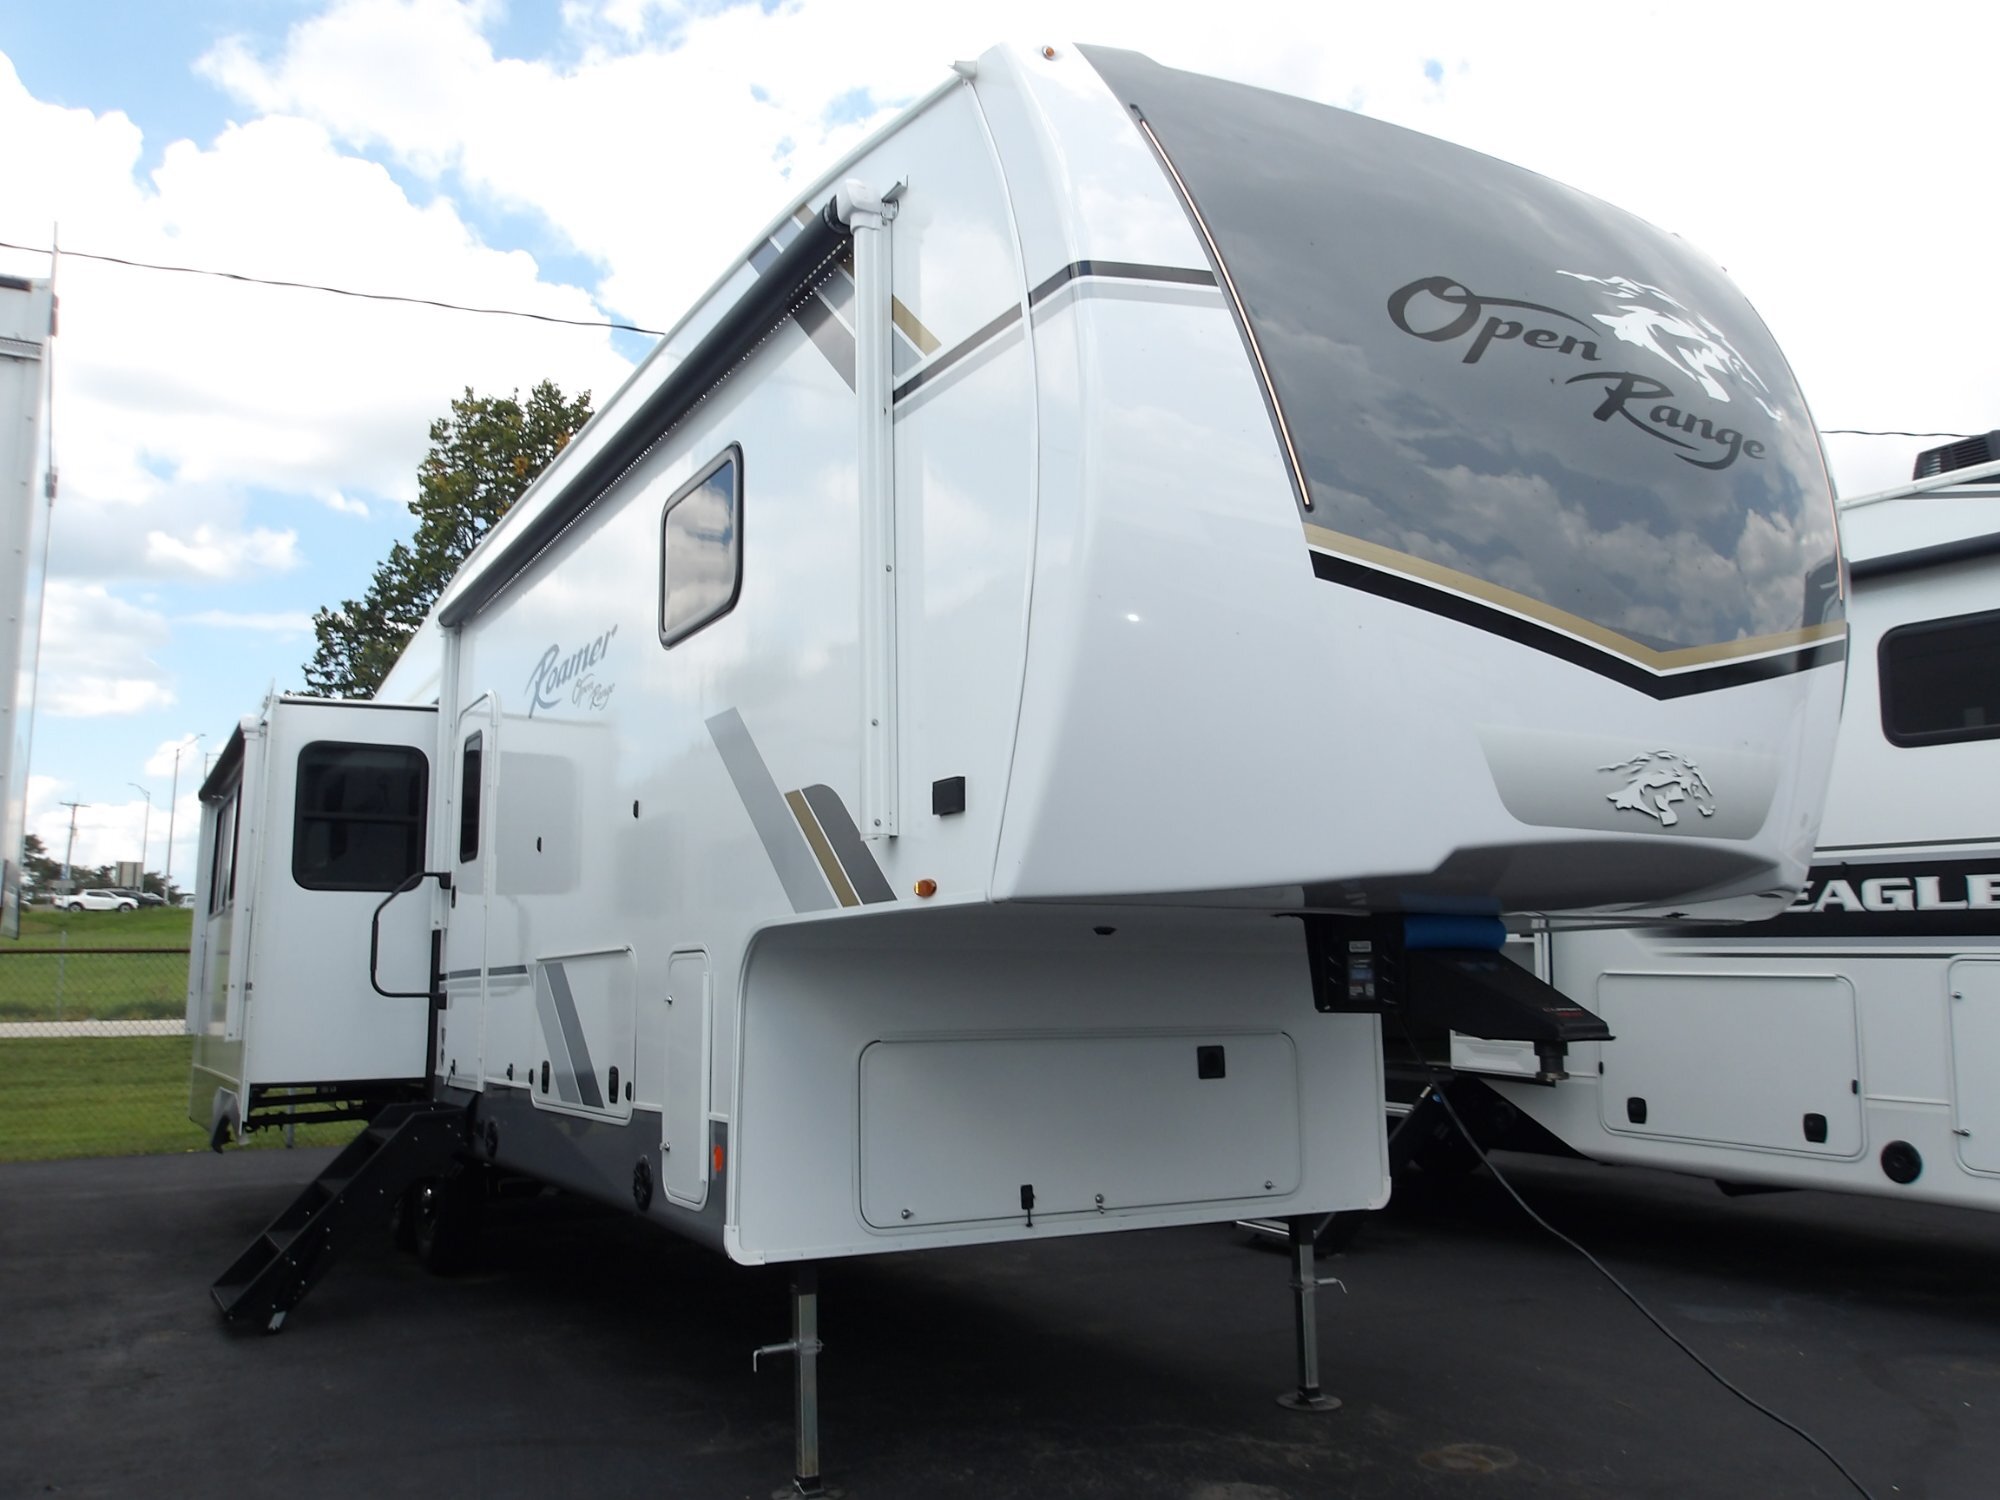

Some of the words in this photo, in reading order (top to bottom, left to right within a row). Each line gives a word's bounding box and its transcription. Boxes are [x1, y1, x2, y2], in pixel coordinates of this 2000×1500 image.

[1387, 276, 1602, 364] Open
[1566, 371, 1766, 471] Range
[525, 624, 618, 718] Roamer
